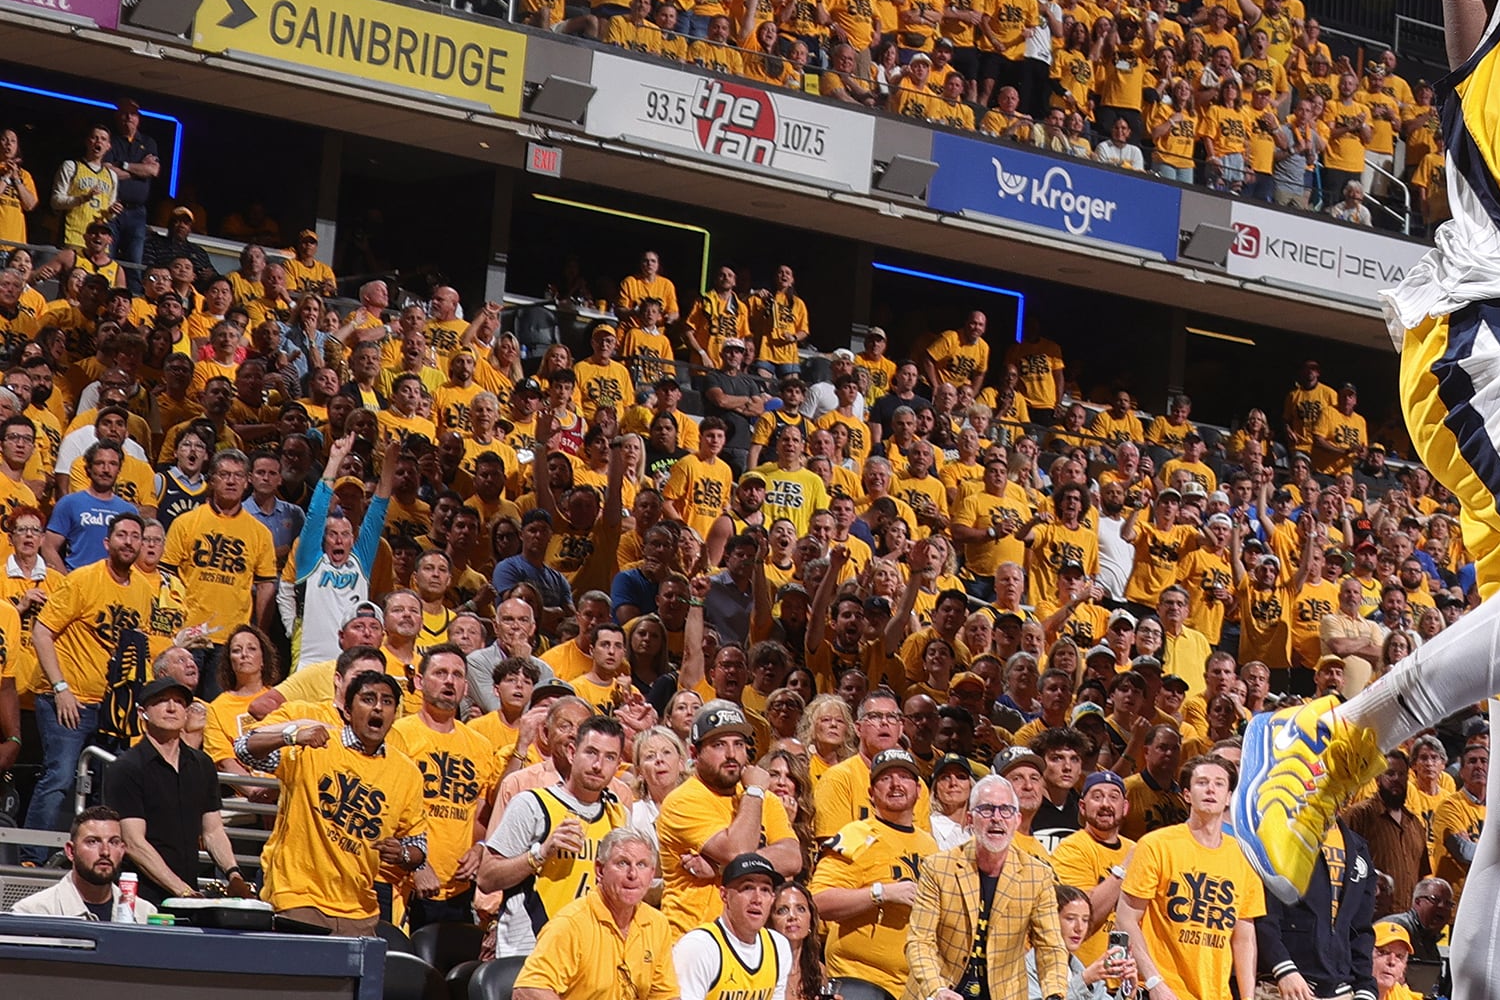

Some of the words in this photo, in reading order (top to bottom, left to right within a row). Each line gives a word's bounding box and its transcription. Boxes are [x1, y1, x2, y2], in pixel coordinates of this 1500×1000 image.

[646, 90, 686, 125] 93.5
[690, 78, 761, 129] the
[782, 121, 826, 156] 107.5
[703, 117, 777, 168] fan
[532, 148, 558, 172] EXIT
[1030, 166, 1117, 236] Kroger
[1265, 236, 1336, 270] KRIEG
[1344, 254, 1411, 282] DEVA
[765, 491, 805, 508] CERS
[772, 479, 803, 495] YES
[79, 511, 102, 528] Rad
[205, 532, 247, 557] YES
[193, 549, 248, 575] CERS
[107, 602, 141, 630] YES
[430, 751, 477, 781] YES
[337, 771, 387, 816] YES
[422, 772, 479, 804] CERS
[317, 790, 384, 841] CERS
[428, 804, 450, 818] 2025
[1183, 871, 1236, 906] YES
[1166, 895, 1238, 931] CERS
[1178, 928, 1201, 945] 2025
[1201, 931, 1227, 950] FINALS
